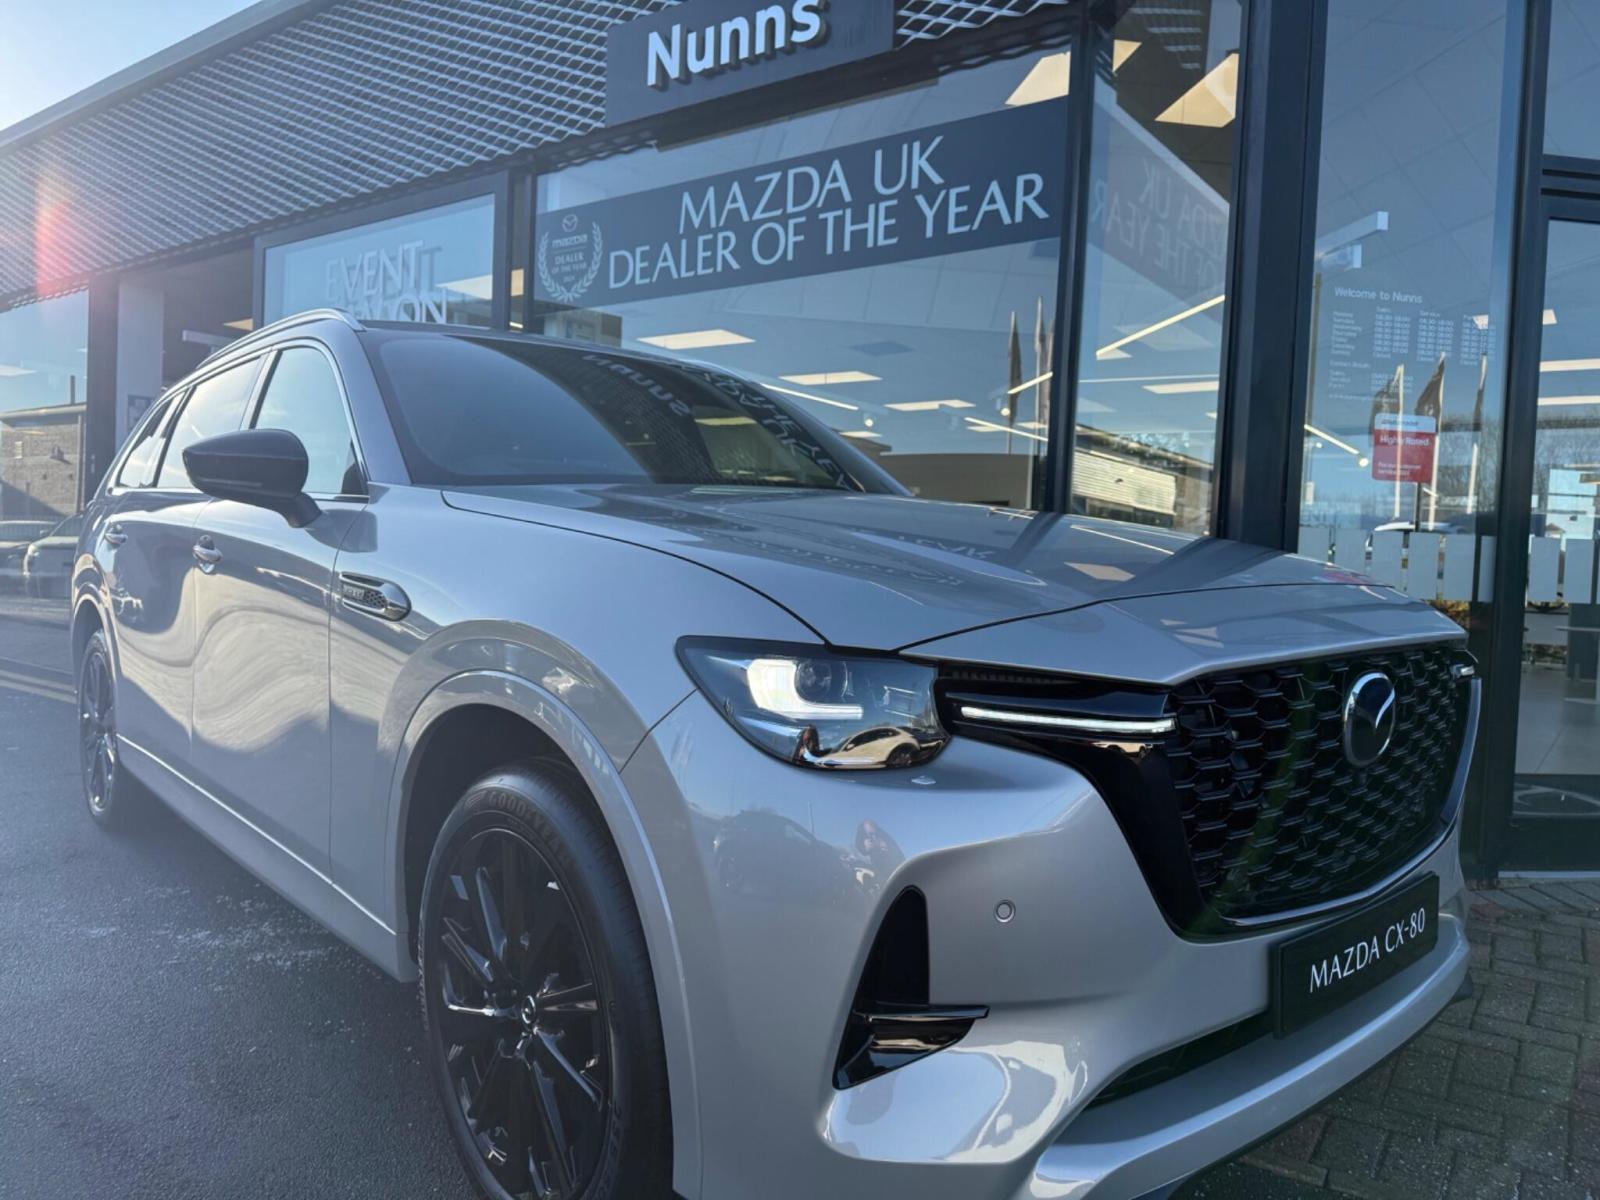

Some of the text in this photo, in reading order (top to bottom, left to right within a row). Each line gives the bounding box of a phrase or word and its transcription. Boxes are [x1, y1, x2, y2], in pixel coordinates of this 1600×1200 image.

[647, 0, 821, 86] Nunns
[678, 135, 945, 235] MAZDA UK
[325, 239, 423, 302] EVENT
[608, 173, 1049, 289] DEALER OF THE YEAR
[1334, 286, 1423, 304] Welcome to Nunns
[1309, 907, 1426, 994] MAZDA CX-80
